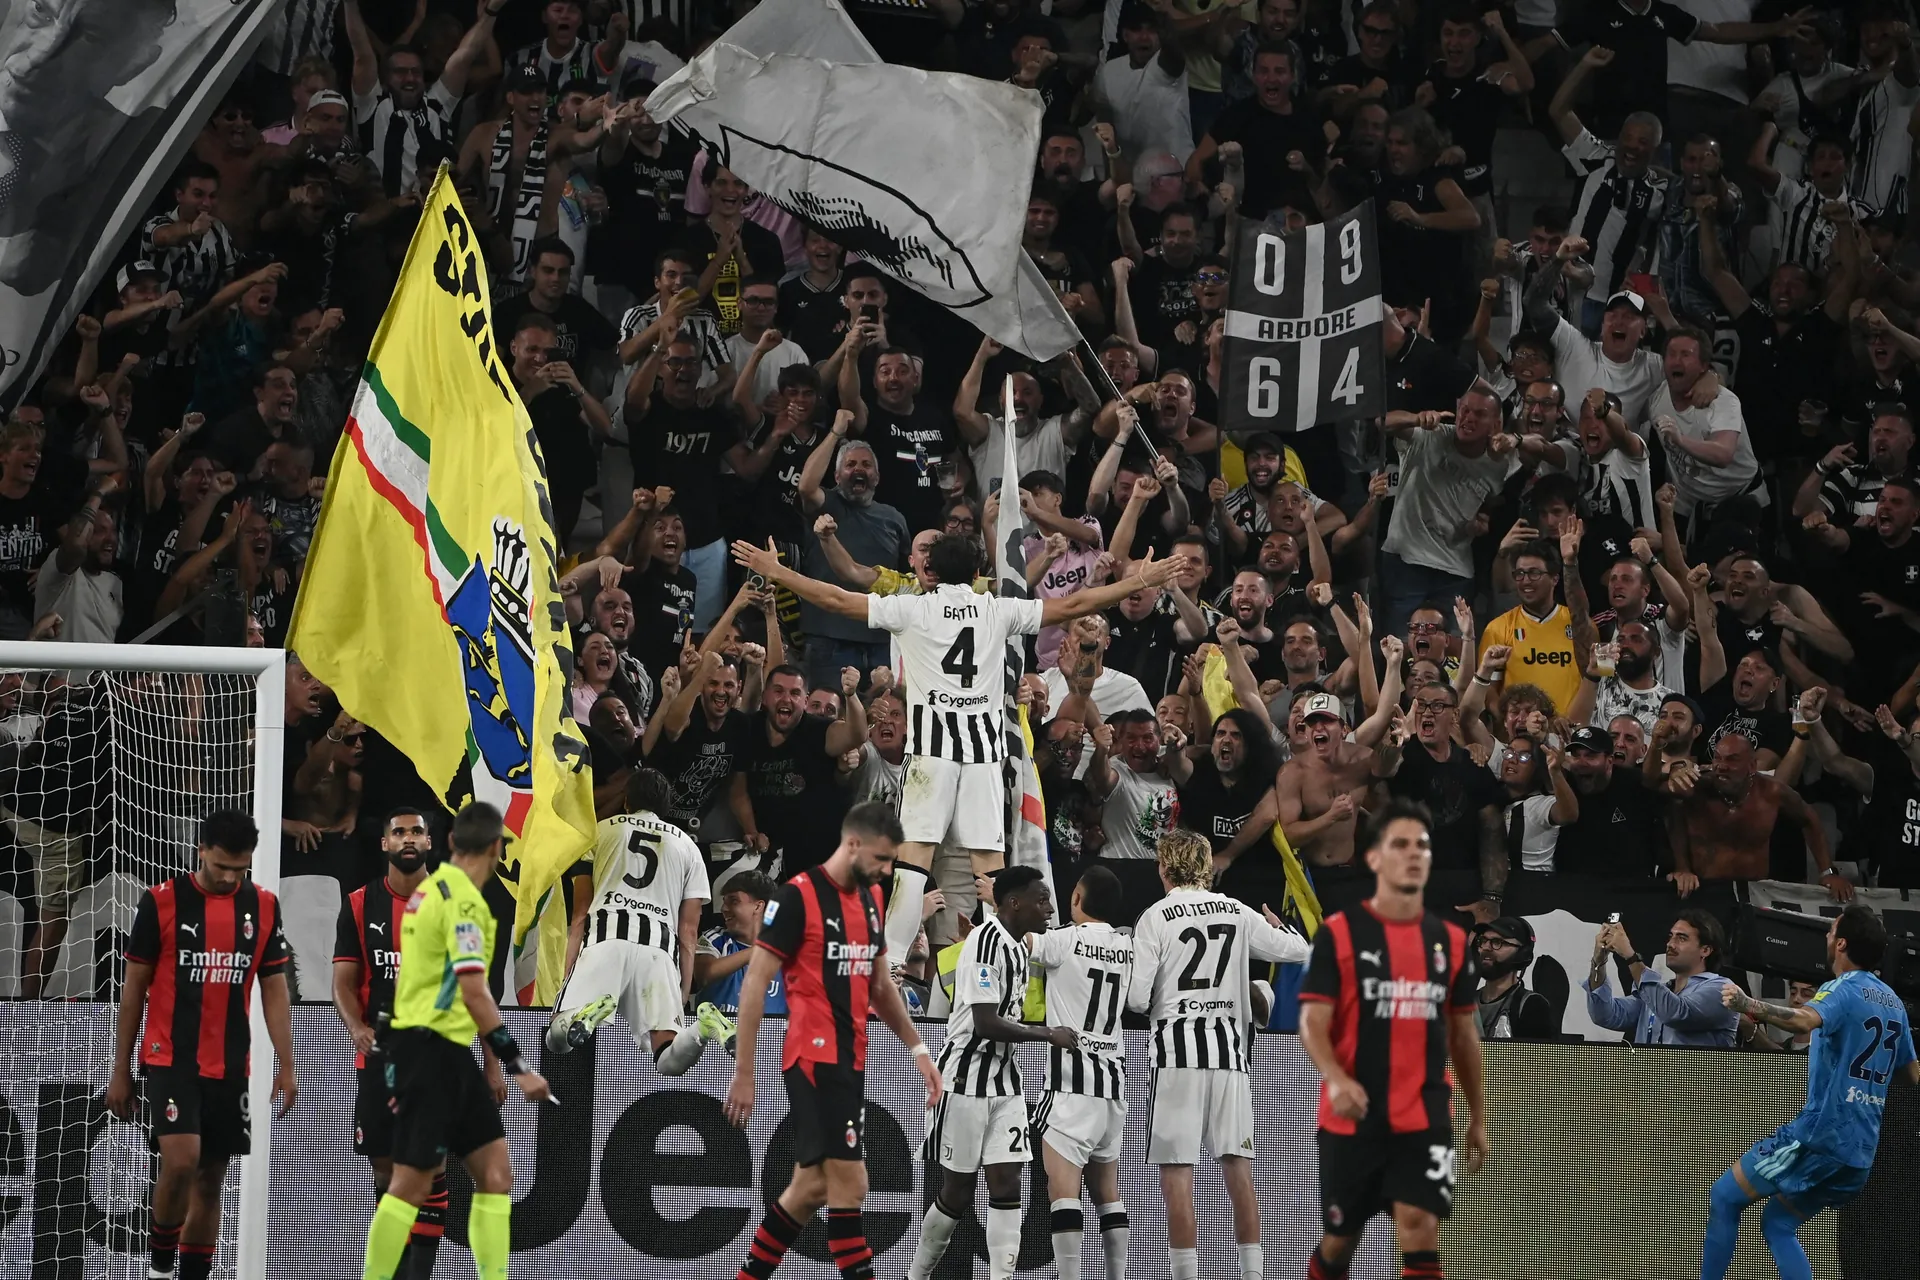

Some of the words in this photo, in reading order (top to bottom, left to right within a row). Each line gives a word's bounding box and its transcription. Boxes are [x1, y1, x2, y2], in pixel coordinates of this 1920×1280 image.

[1339, 218, 1363, 285] 9
[1258, 307, 1356, 340] ARDORE
[1247, 356, 1281, 418] 6
[1331, 346, 1364, 405] 4
[663, 431, 711, 455] 1977
[778, 465, 800, 487] Je
[918, 477, 930, 487] NOI
[1044, 566, 1087, 590] Jeep
[944, 605, 979, 621] GATTI
[941, 627, 978, 688] 4
[1523, 648, 1572, 667] Jeep
[939, 693, 989, 708] Cygames
[610, 816, 682, 839] LOCATELLI
[623, 830, 662, 889] 5
[614, 893, 669, 917] Cygames
[1162, 901, 1240, 922] WOLTEMADE
[827, 940, 879, 960] Emirat
[1766, 936, 1788, 946] Canon
[179, 948, 252, 968] Emirates
[1178, 923, 1236, 991] 27
[190, 968, 208, 982] FLY
[1083, 967, 1120, 1035] 11
[1849, 1016, 1902, 1085] 23
[1008, 1125, 1030, 1153] 26
